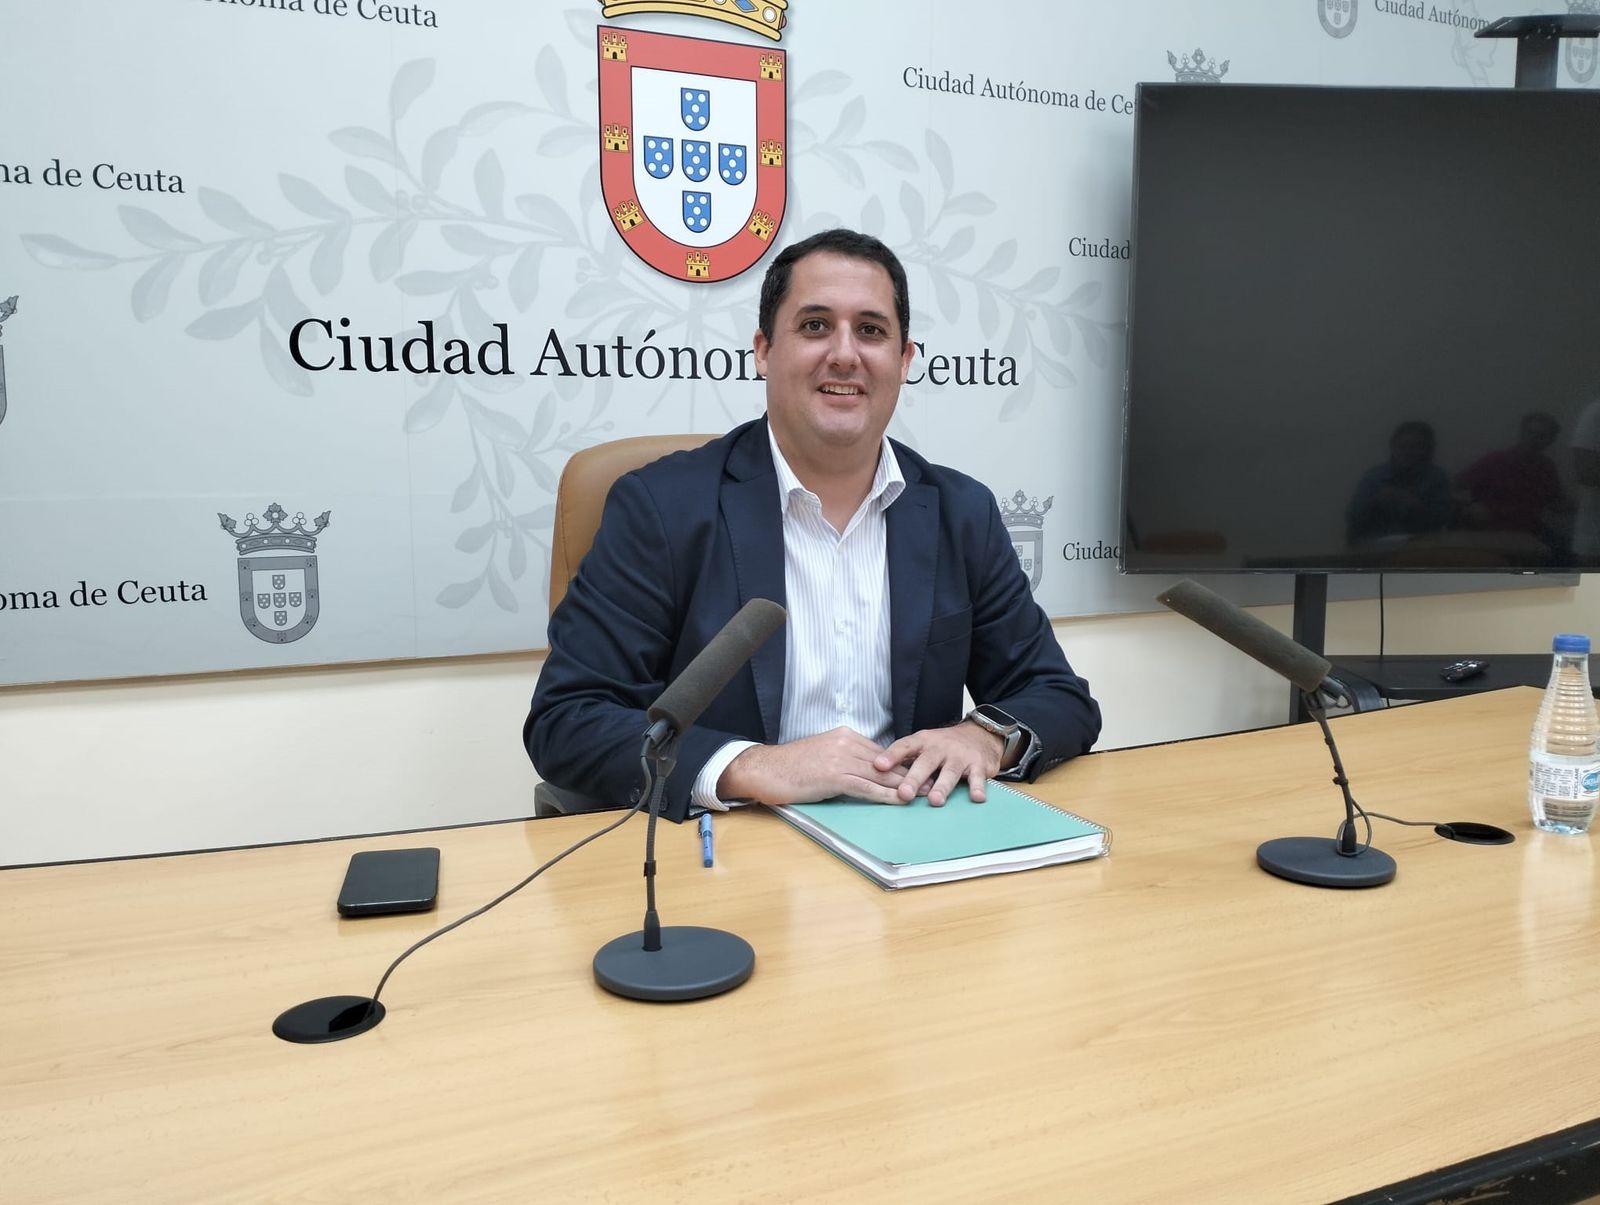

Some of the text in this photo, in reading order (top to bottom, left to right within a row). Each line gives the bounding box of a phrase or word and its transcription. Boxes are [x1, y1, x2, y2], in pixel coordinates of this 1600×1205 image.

[357, 0, 439, 28] Ceuta
[1375, 0, 1491, 31] Ciudad Autónom
[903, 66, 1136, 115] Ciudad Autónoma de Ce
[42, 158, 82, 188] de
[92, 163, 186, 193] Ceuta
[1068, 237, 1130, 260] Ciudad
[289, 317, 515, 376] Ciudad
[69, 580, 108, 607] de
[117, 579, 208, 605] Ceuta
